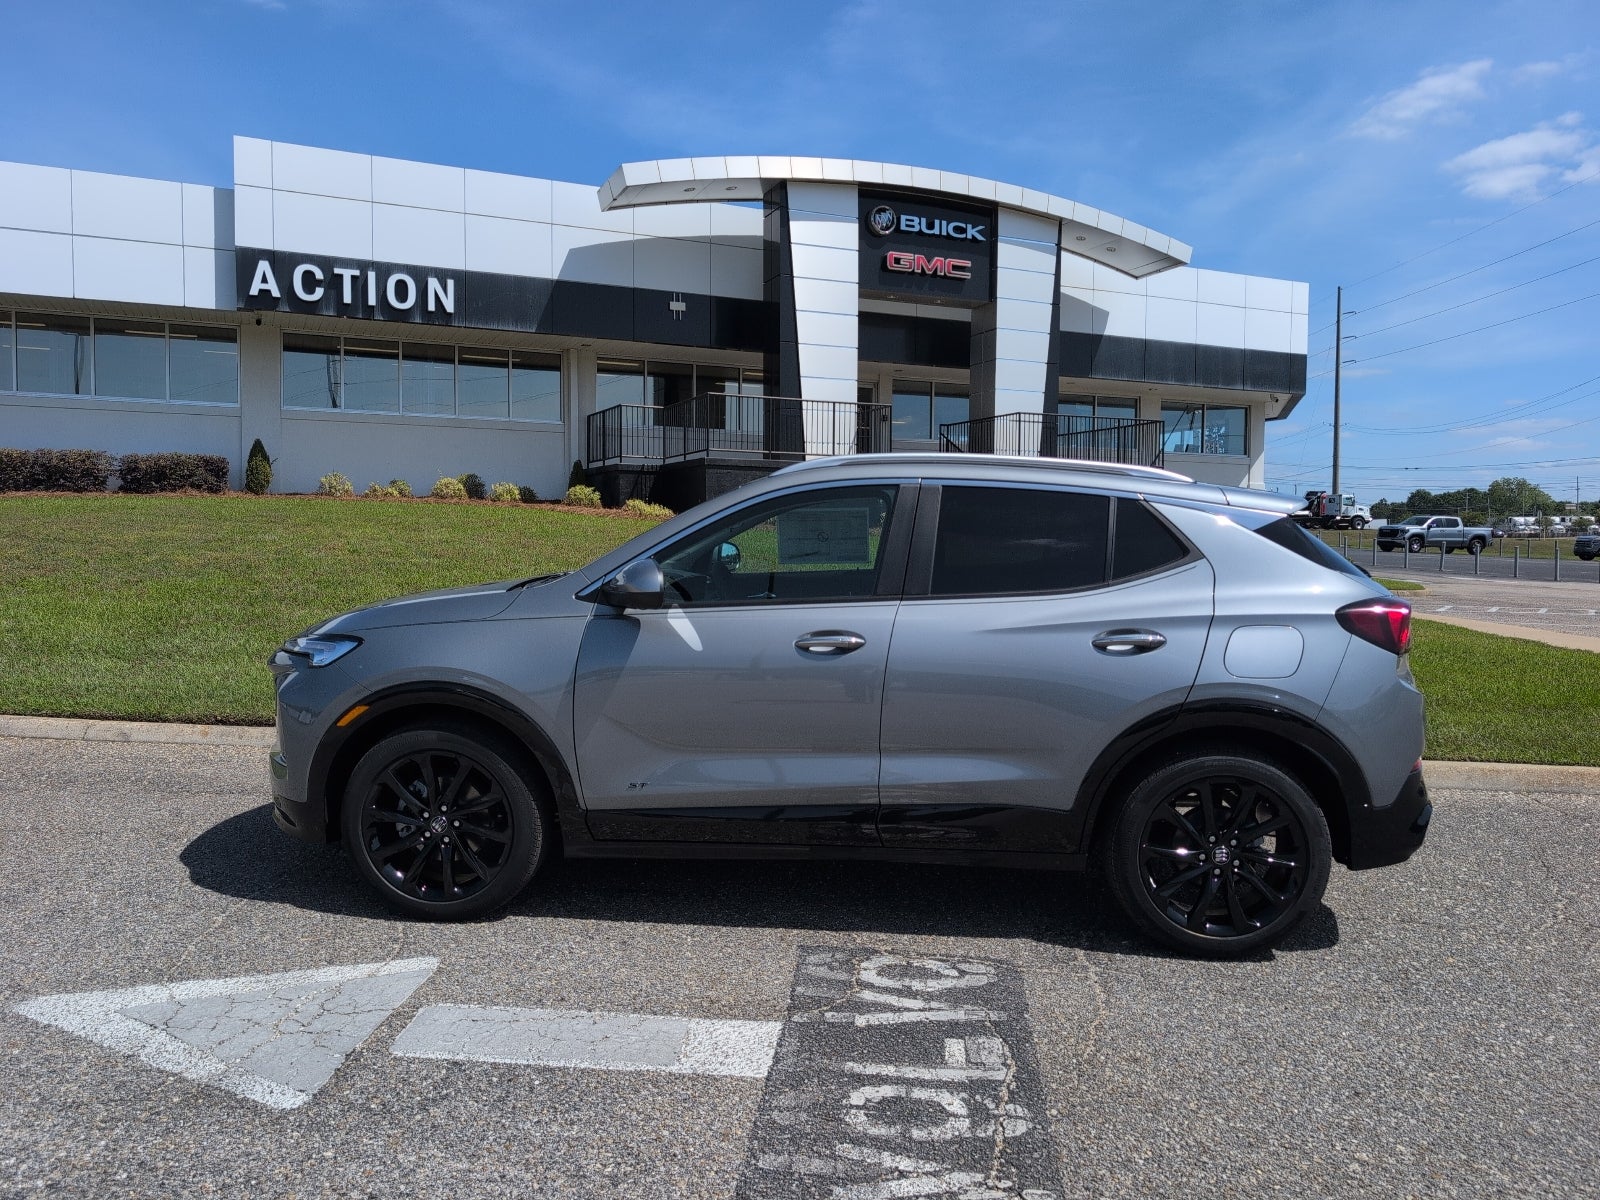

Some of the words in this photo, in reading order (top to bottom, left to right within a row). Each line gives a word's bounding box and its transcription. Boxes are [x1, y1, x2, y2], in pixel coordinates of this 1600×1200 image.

[900, 214, 986, 241] BUICK
[886, 250, 972, 279] GMC
[249, 259, 455, 314] ACTION
